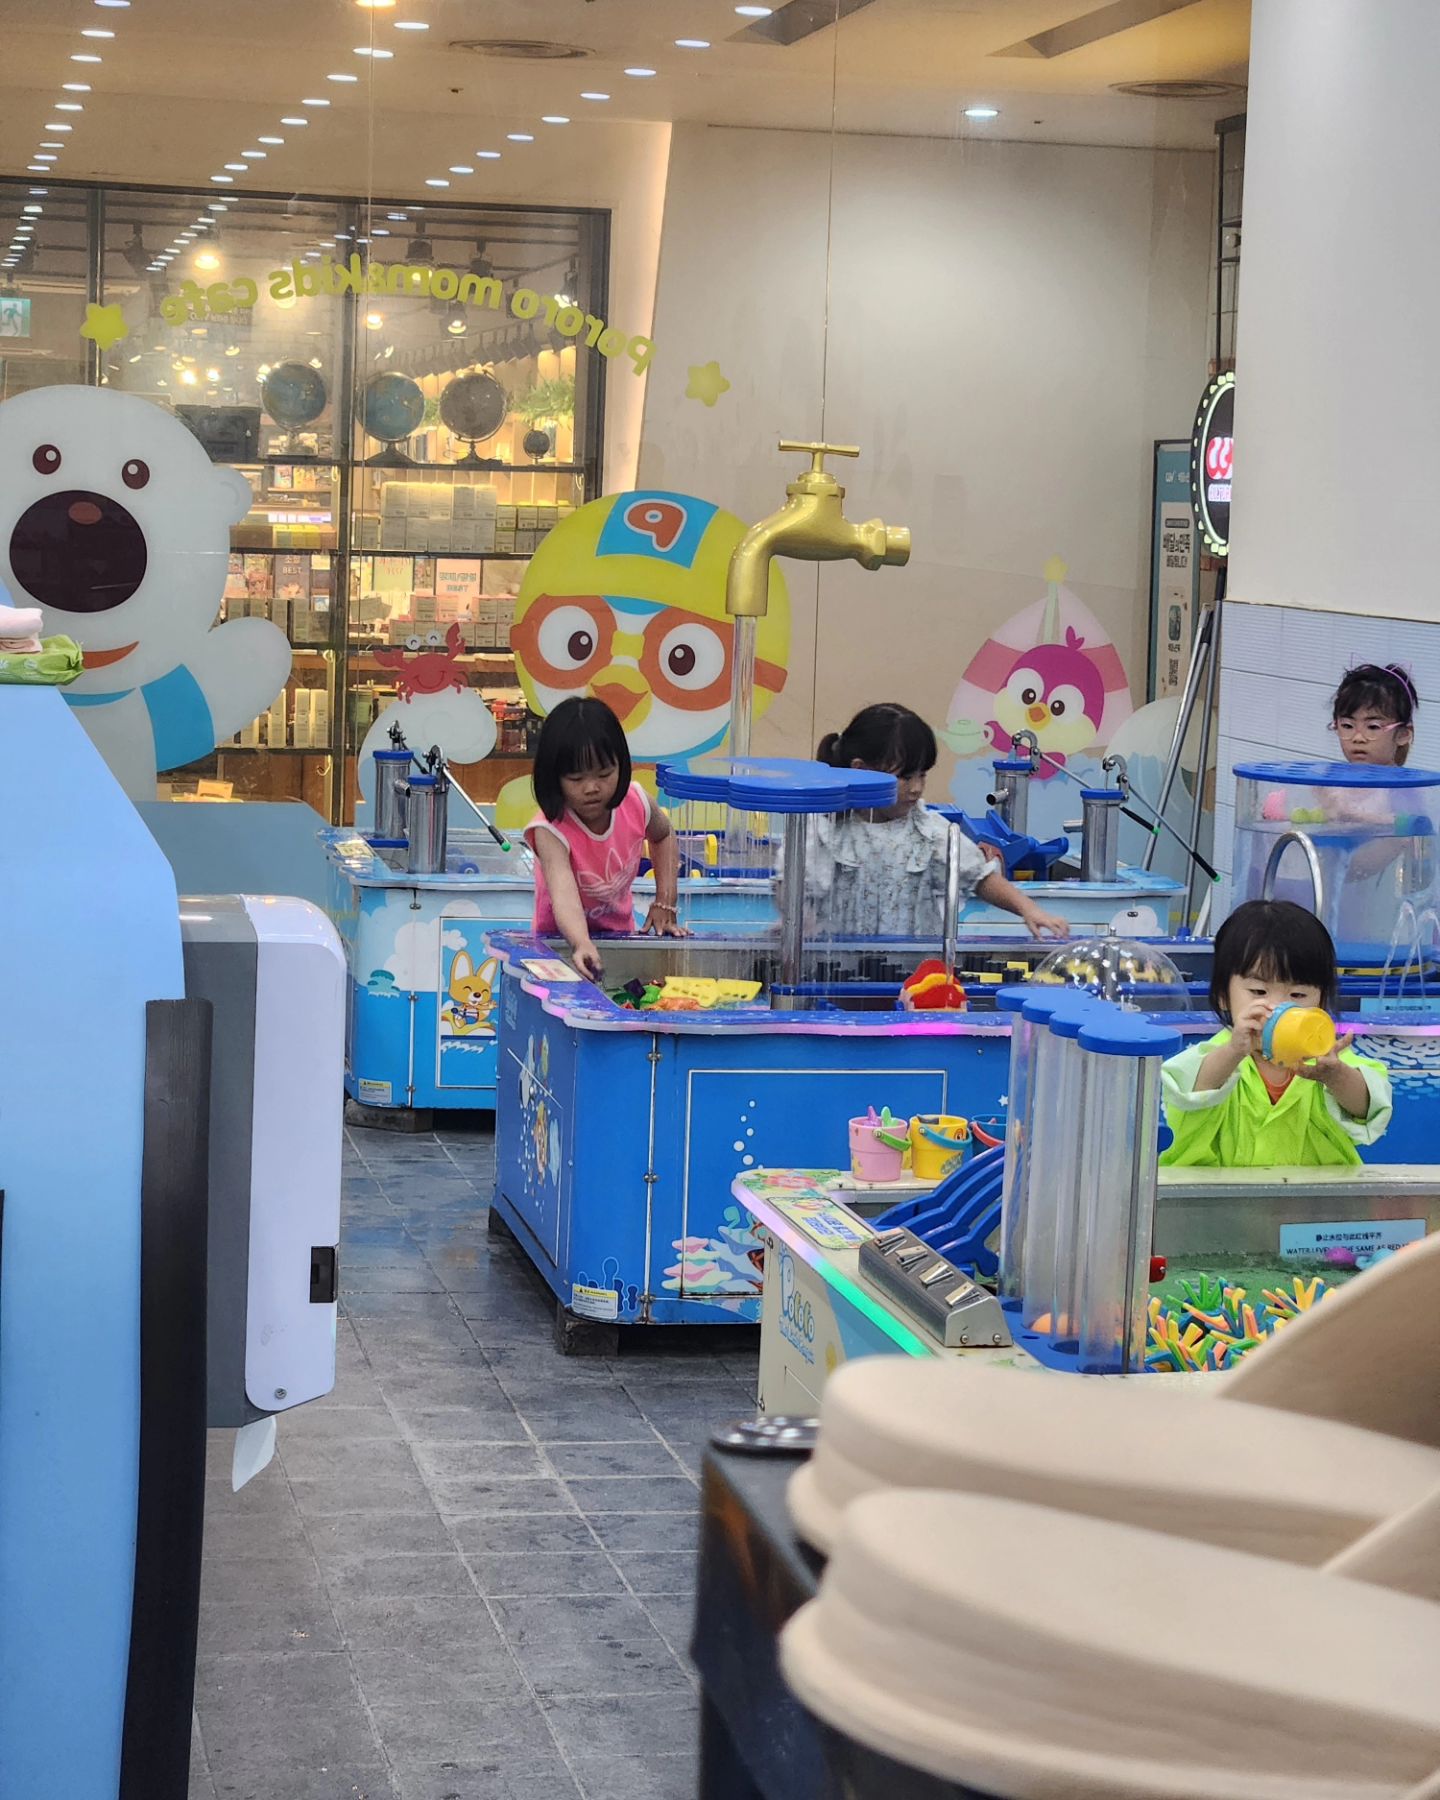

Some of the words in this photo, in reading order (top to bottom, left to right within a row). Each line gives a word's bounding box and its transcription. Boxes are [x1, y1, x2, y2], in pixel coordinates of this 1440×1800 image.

[282, 566, 302, 574] BEST
[1286, 1247, 1310, 1255] WATER
[1311, 1246, 1330, 1254] LEVE
[1387, 1243, 1400, 1251] RED
